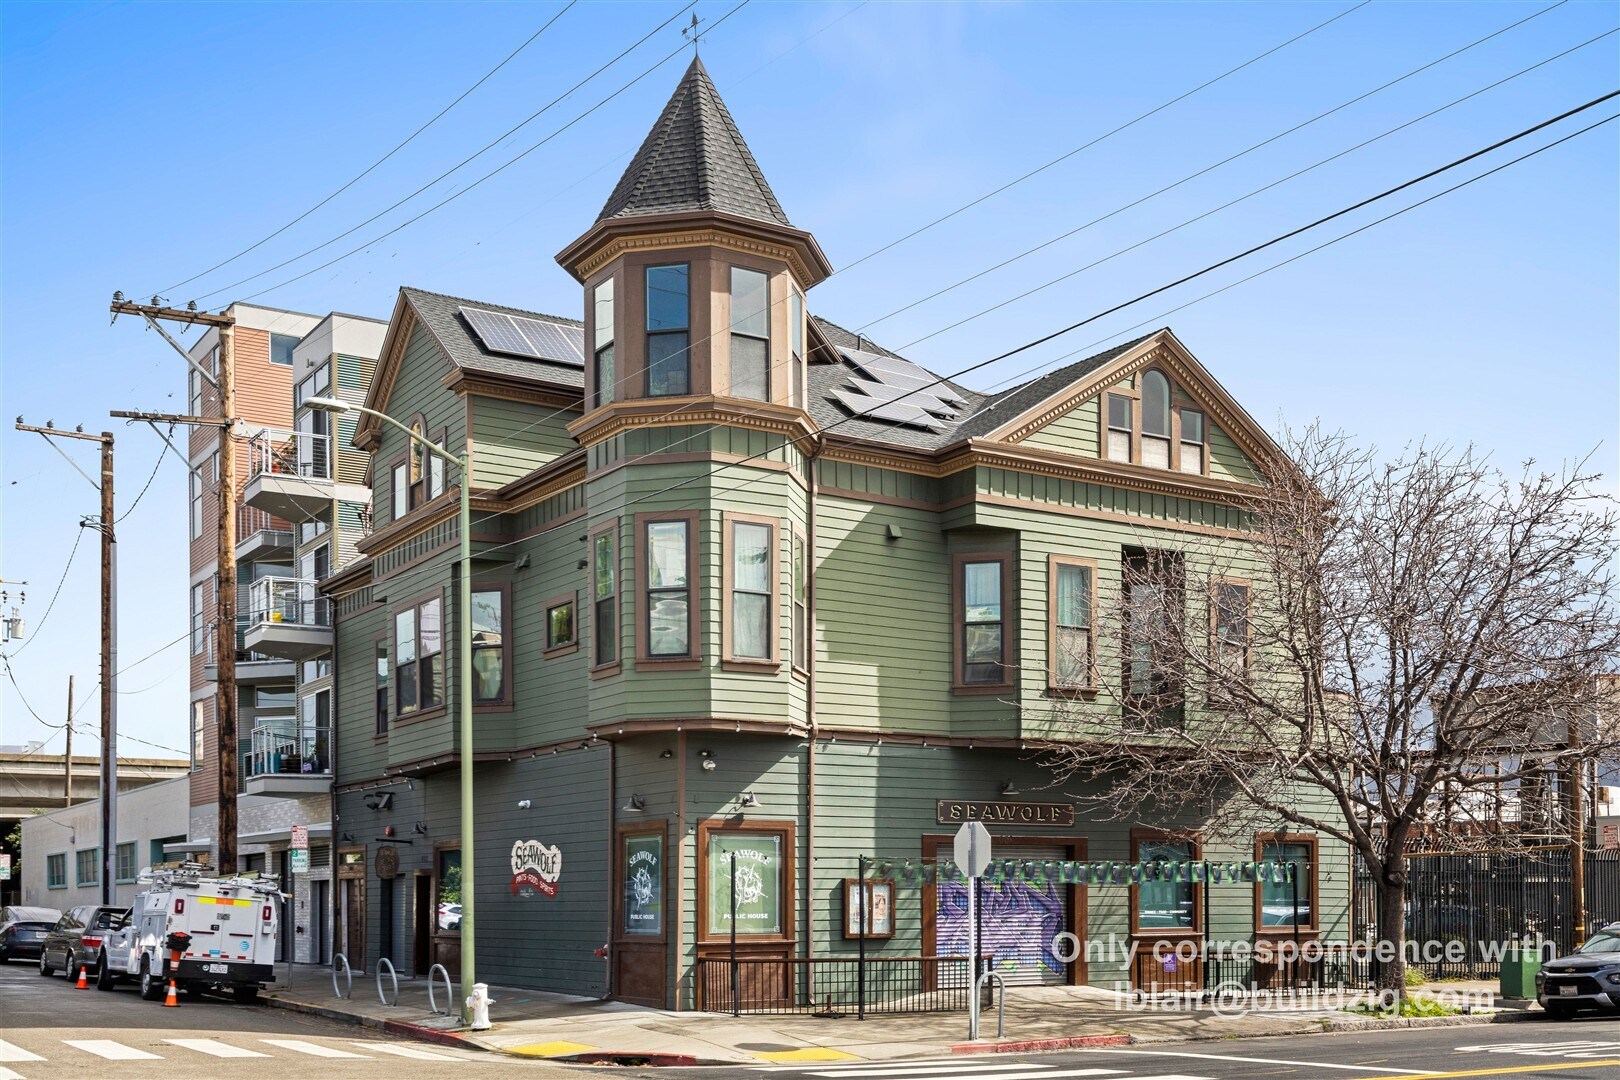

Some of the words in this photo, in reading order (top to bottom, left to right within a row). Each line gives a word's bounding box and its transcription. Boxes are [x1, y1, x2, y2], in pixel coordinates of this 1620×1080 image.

[950, 804, 1061, 821] SEAWOLF
[515, 845, 557, 874] SEAWOLF
[629, 850, 658, 867] SEAWOLF
